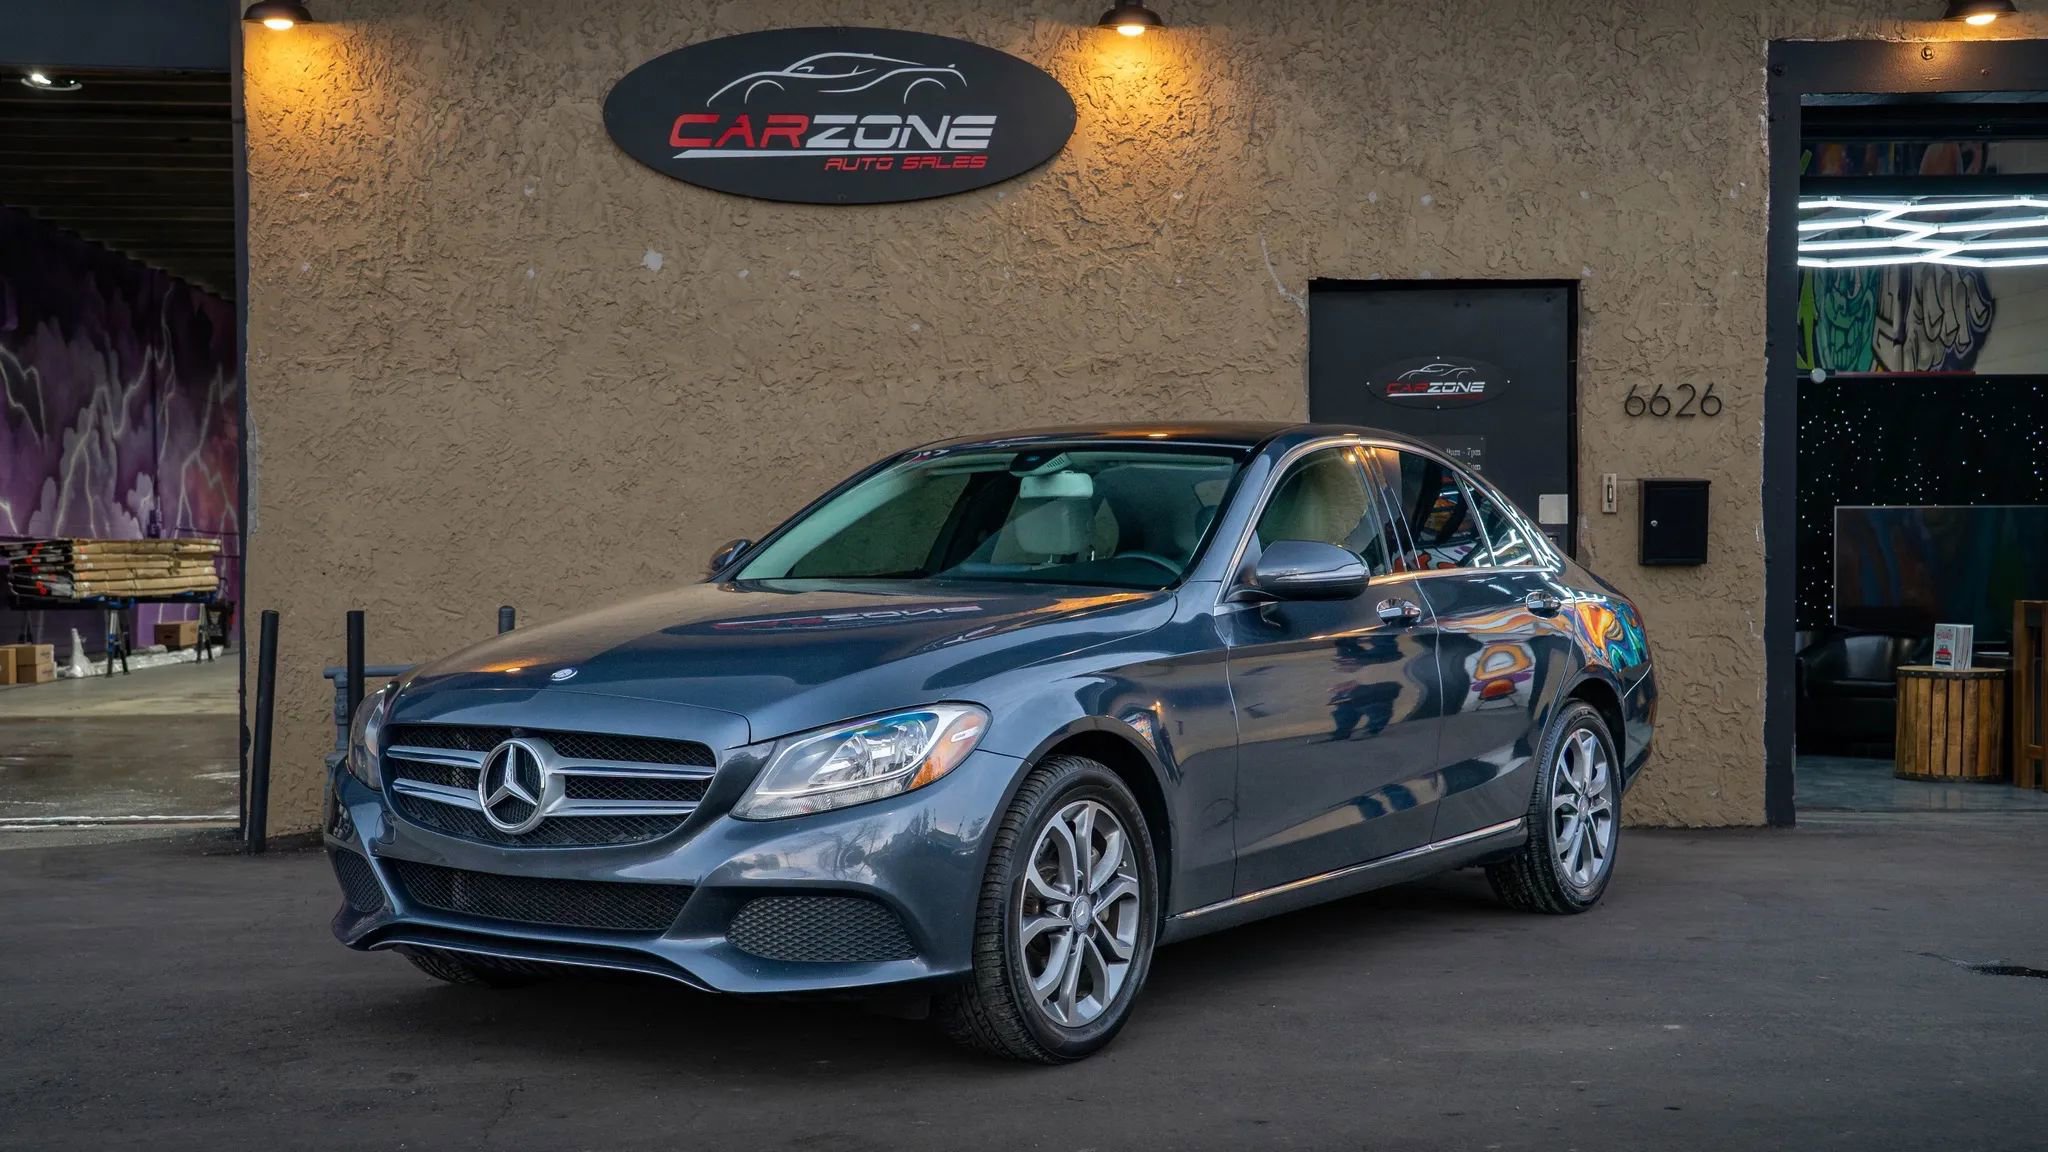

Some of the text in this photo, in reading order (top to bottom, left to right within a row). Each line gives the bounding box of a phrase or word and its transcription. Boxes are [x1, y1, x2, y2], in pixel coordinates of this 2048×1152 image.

[669, 113, 997, 149] CARZONE
[824, 155, 988, 171] AUTO SALES
[1624, 382, 1722, 417] 6626
